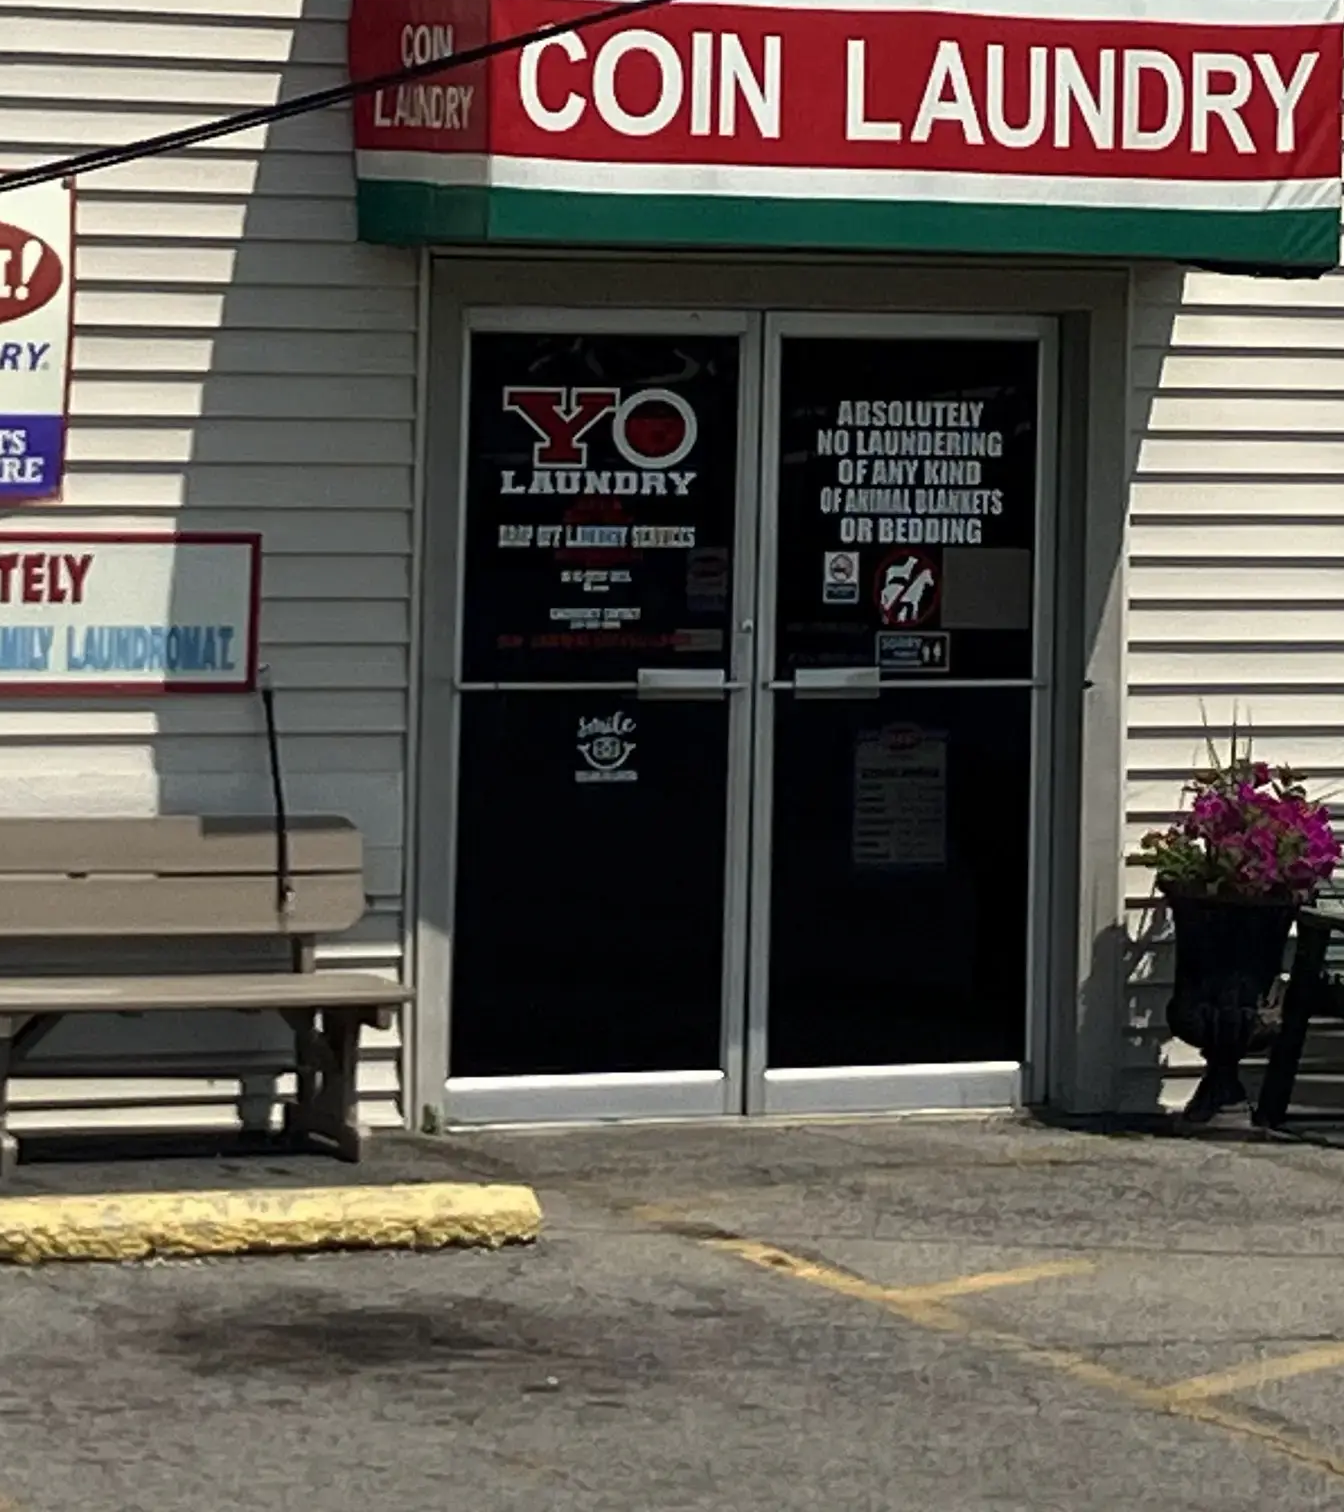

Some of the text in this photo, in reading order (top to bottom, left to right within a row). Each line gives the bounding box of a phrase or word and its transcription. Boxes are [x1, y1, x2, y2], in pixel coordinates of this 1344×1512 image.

[400, 24, 454, 68] COIN
[519, 21, 1321, 155] COIN LAUNDRY
[374, 83, 474, 129] LAUNDRY
[836, 400, 984, 428] ABSOLUTELY
[817, 430, 1004, 457] NO LAUNDERING
[499, 470, 697, 496] LAUNDRY
[837, 459, 982, 486] OF ANY KIND
[819, 486, 842, 514] OF
[844, 487, 912, 514] ANIMAL
[840, 517, 983, 544] OR BEDDING
